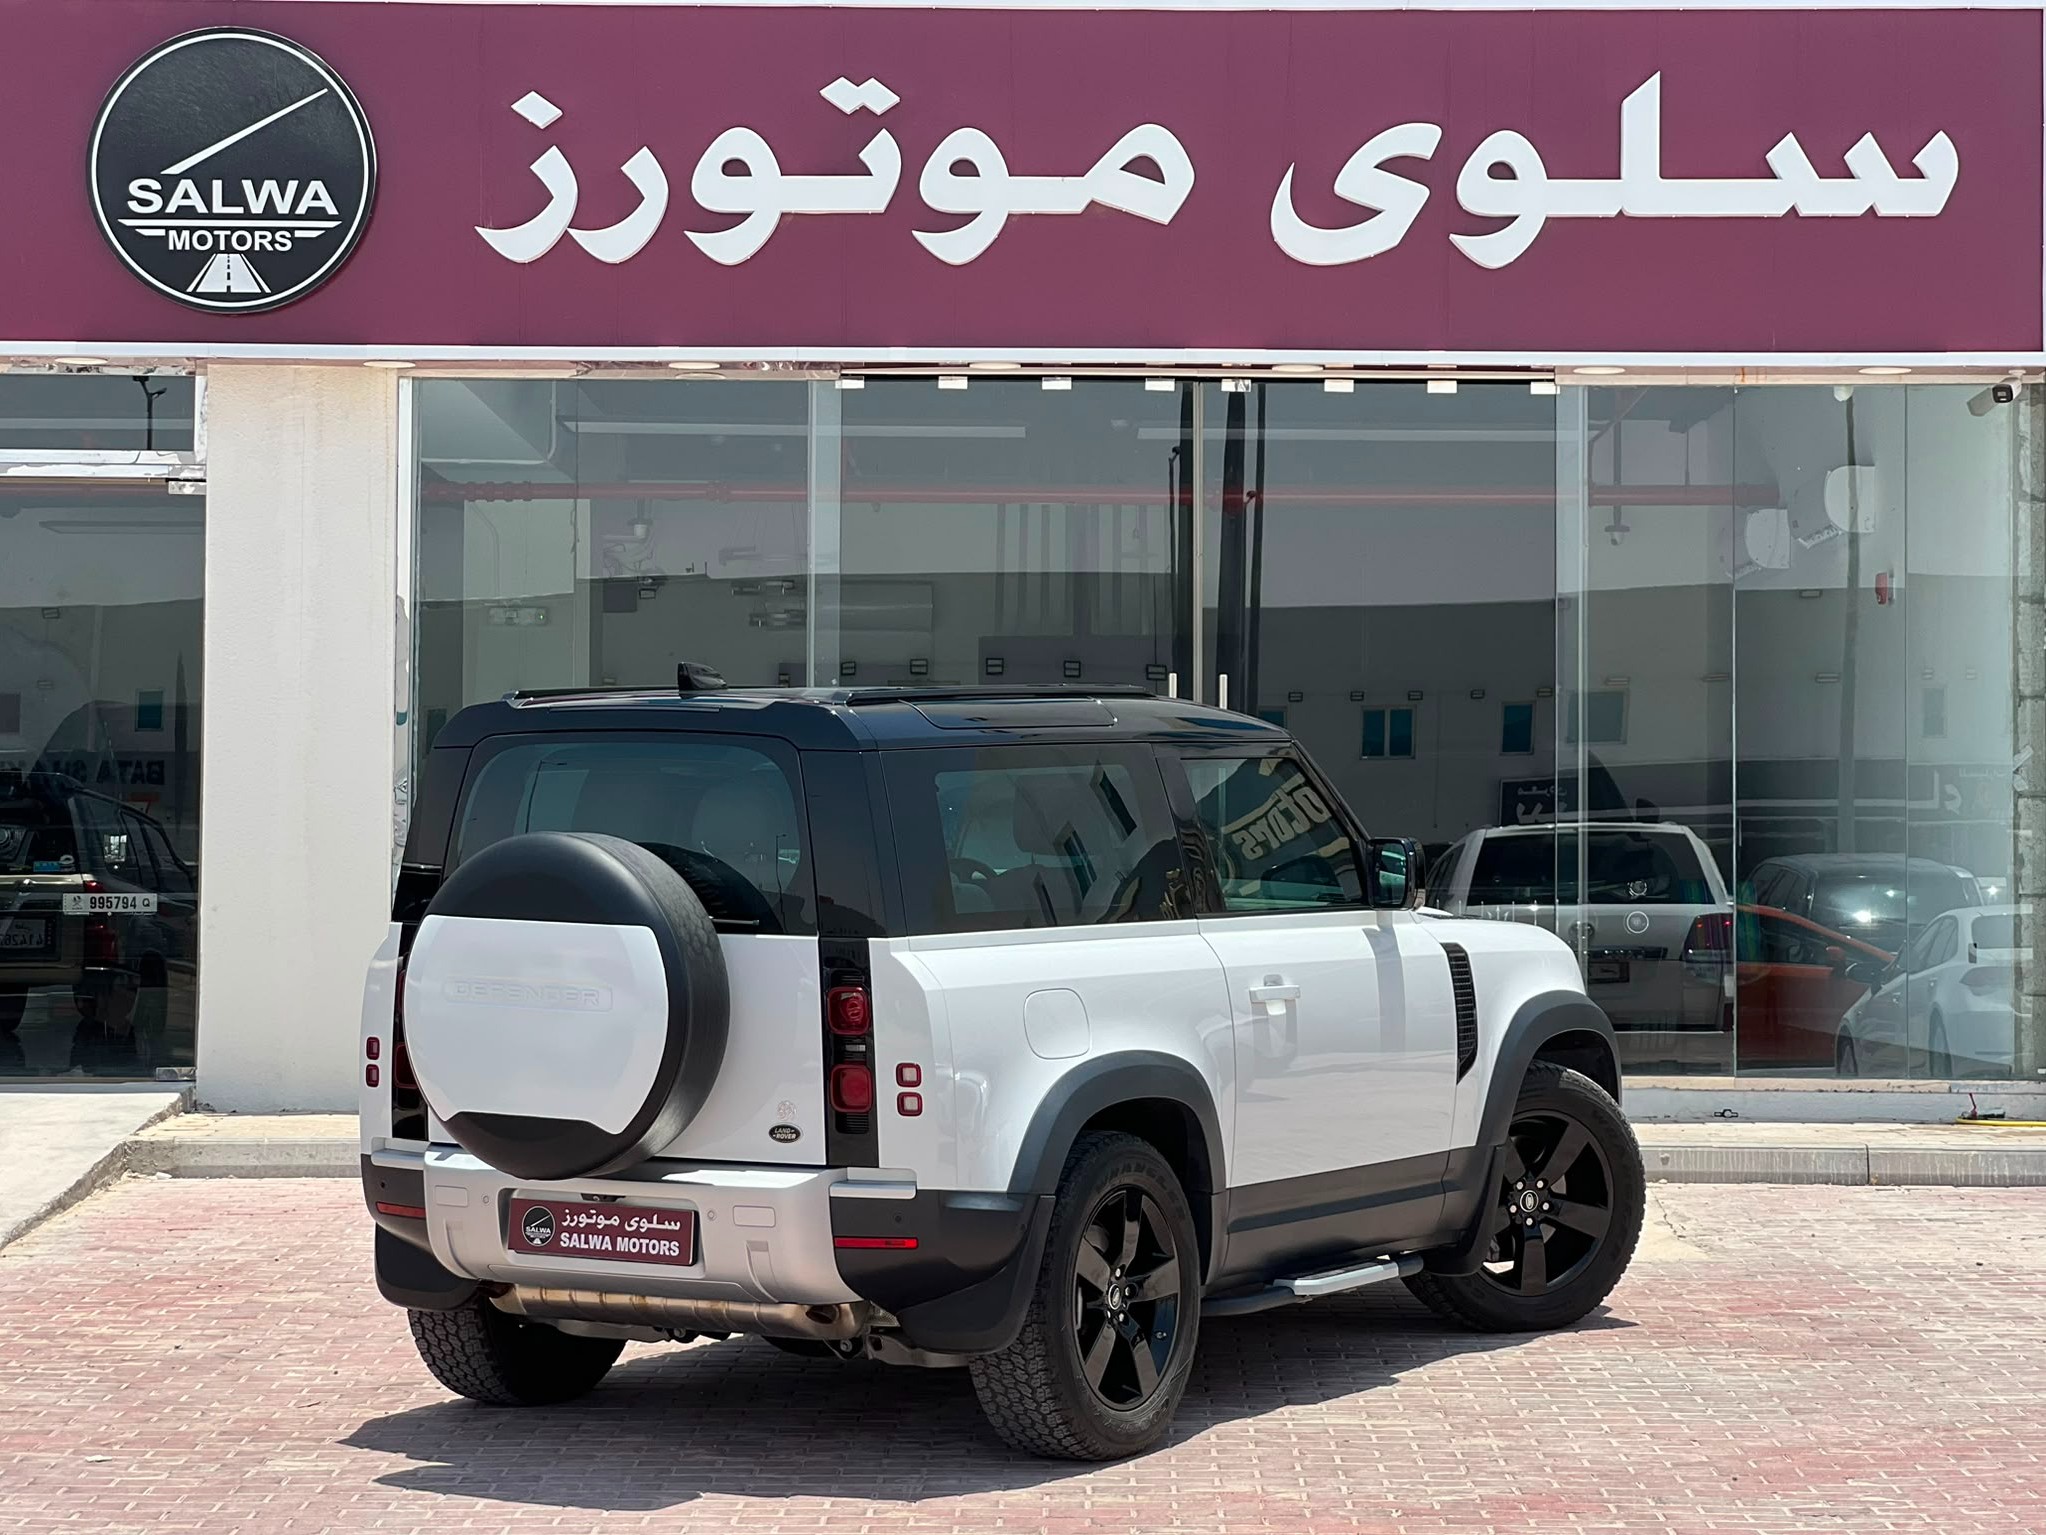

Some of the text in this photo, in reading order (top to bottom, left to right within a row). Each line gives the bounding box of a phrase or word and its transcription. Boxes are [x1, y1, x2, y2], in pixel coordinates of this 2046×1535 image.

[475, 71, 1960, 270] سلوى موتورز
[127, 178, 340, 216] SALWA
[167, 229, 293, 253] MOTORS
[90, 896, 137, 909] 995794
[455, 981, 600, 1006] DEFENDER
[562, 1209, 680, 1232] سلوى موتورز
[560, 1232, 680, 1256] SALWA MOTORS
